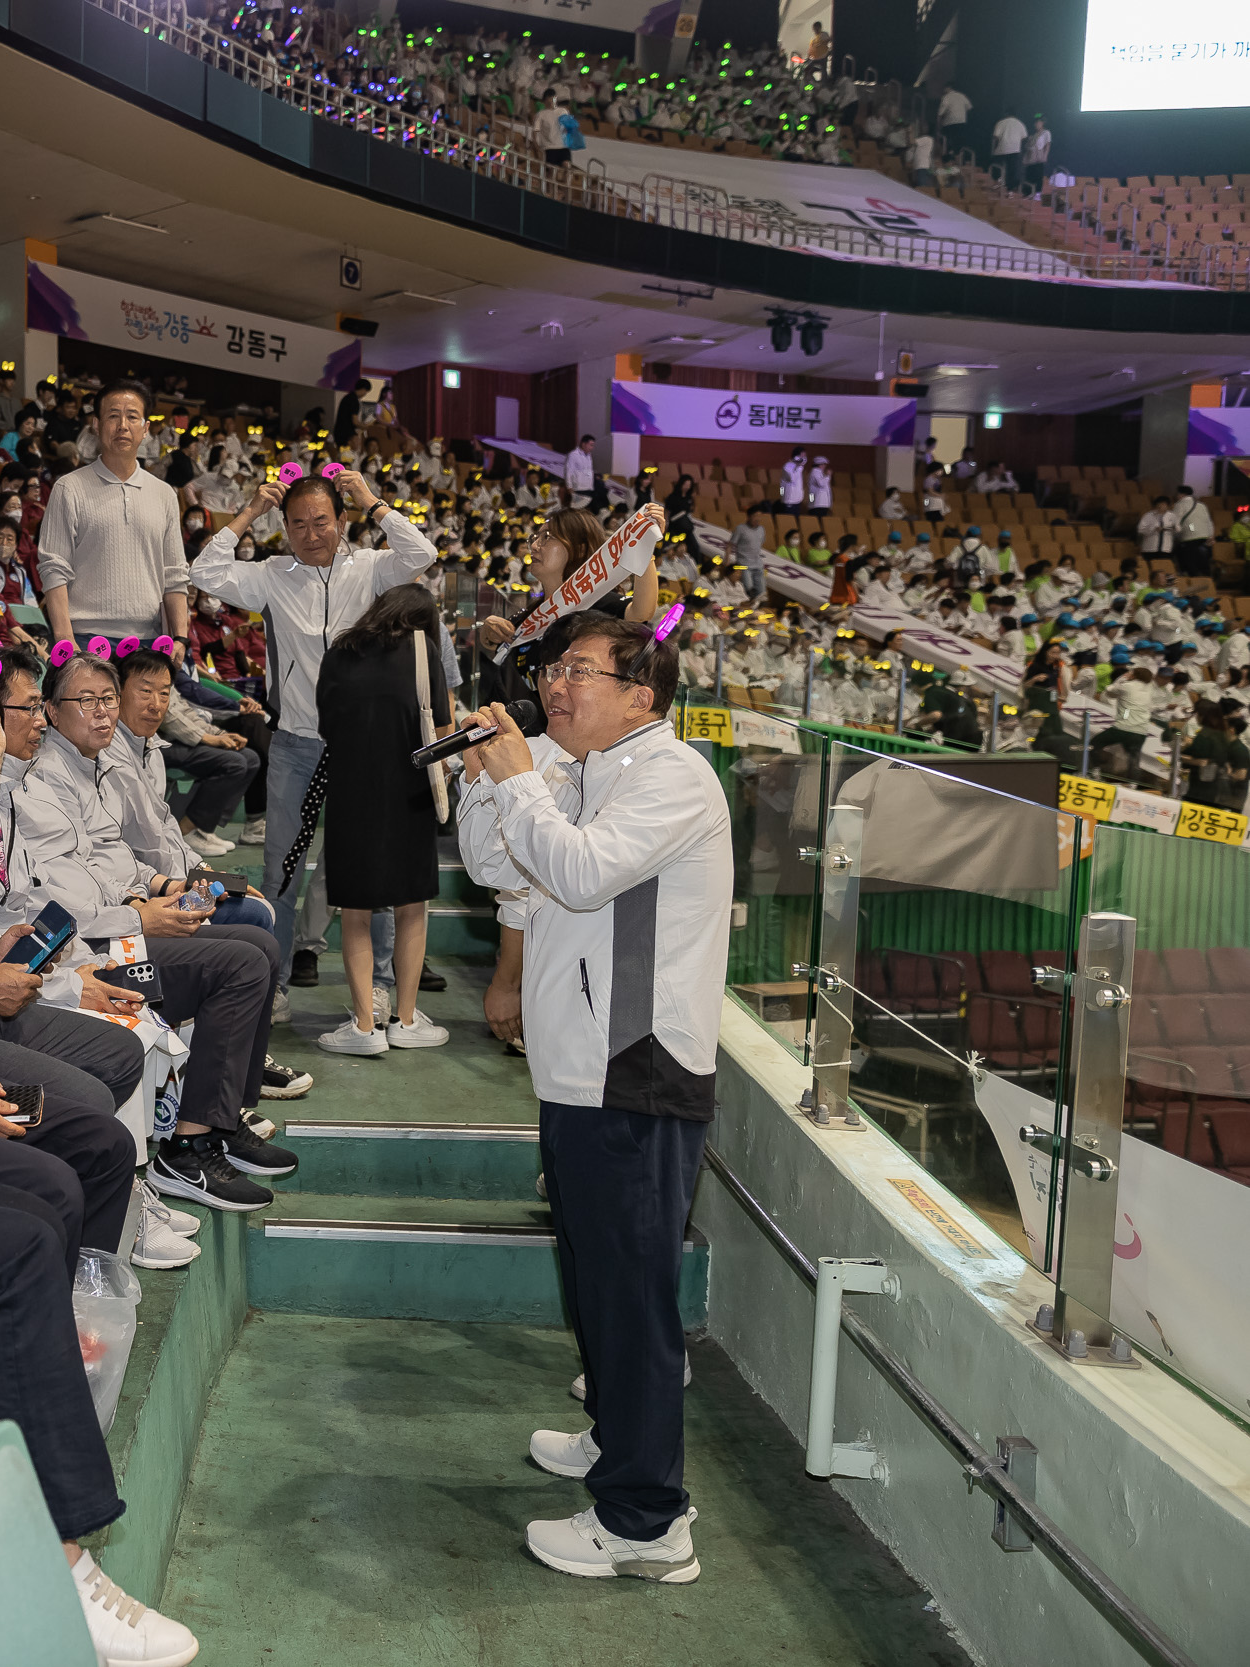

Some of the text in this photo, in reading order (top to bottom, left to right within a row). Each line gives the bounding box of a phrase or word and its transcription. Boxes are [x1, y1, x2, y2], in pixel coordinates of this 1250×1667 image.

[1111, 44, 1163, 62] 책임을
[163, 311, 189, 344] 강동
[226, 325, 287, 362] 강동구
[748, 404, 821, 430] 동대문구
[283, 467, 296, 478] 광진
[327, 467, 341, 477] 광진
[560, 549, 608, 606] 체육회
[57, 648, 69, 659] 광진
[94, 643, 107, 656] 광진
[1187, 809, 1239, 838] 강동구
